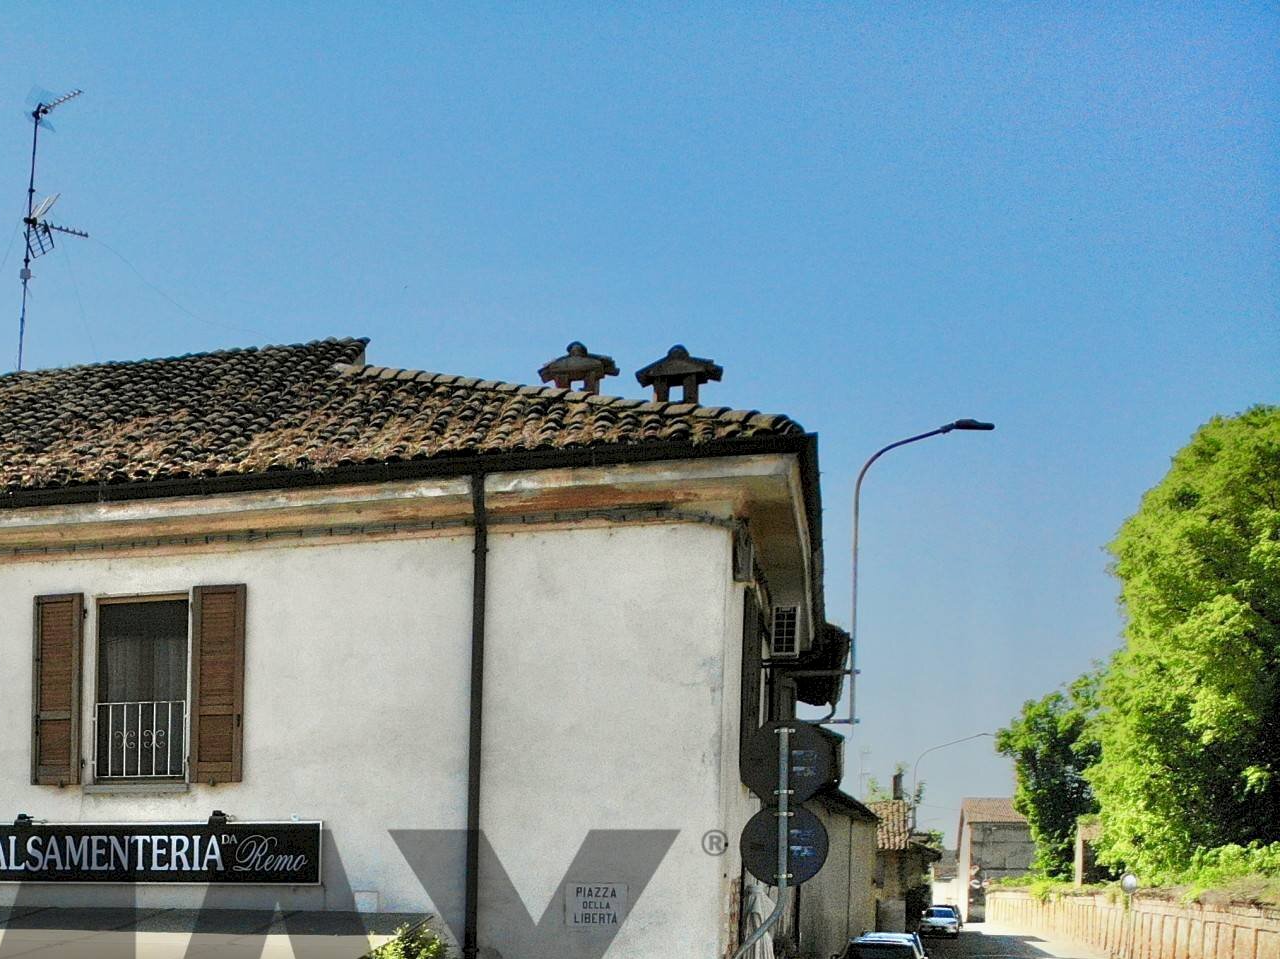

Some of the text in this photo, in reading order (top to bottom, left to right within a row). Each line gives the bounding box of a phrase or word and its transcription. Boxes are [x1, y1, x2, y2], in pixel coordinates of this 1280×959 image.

[221, 834, 238, 845] DA
[232, 834, 309, 872] Remo
[575, 886, 617, 898] PIAZZA
[582, 900, 611, 910] DELLA
